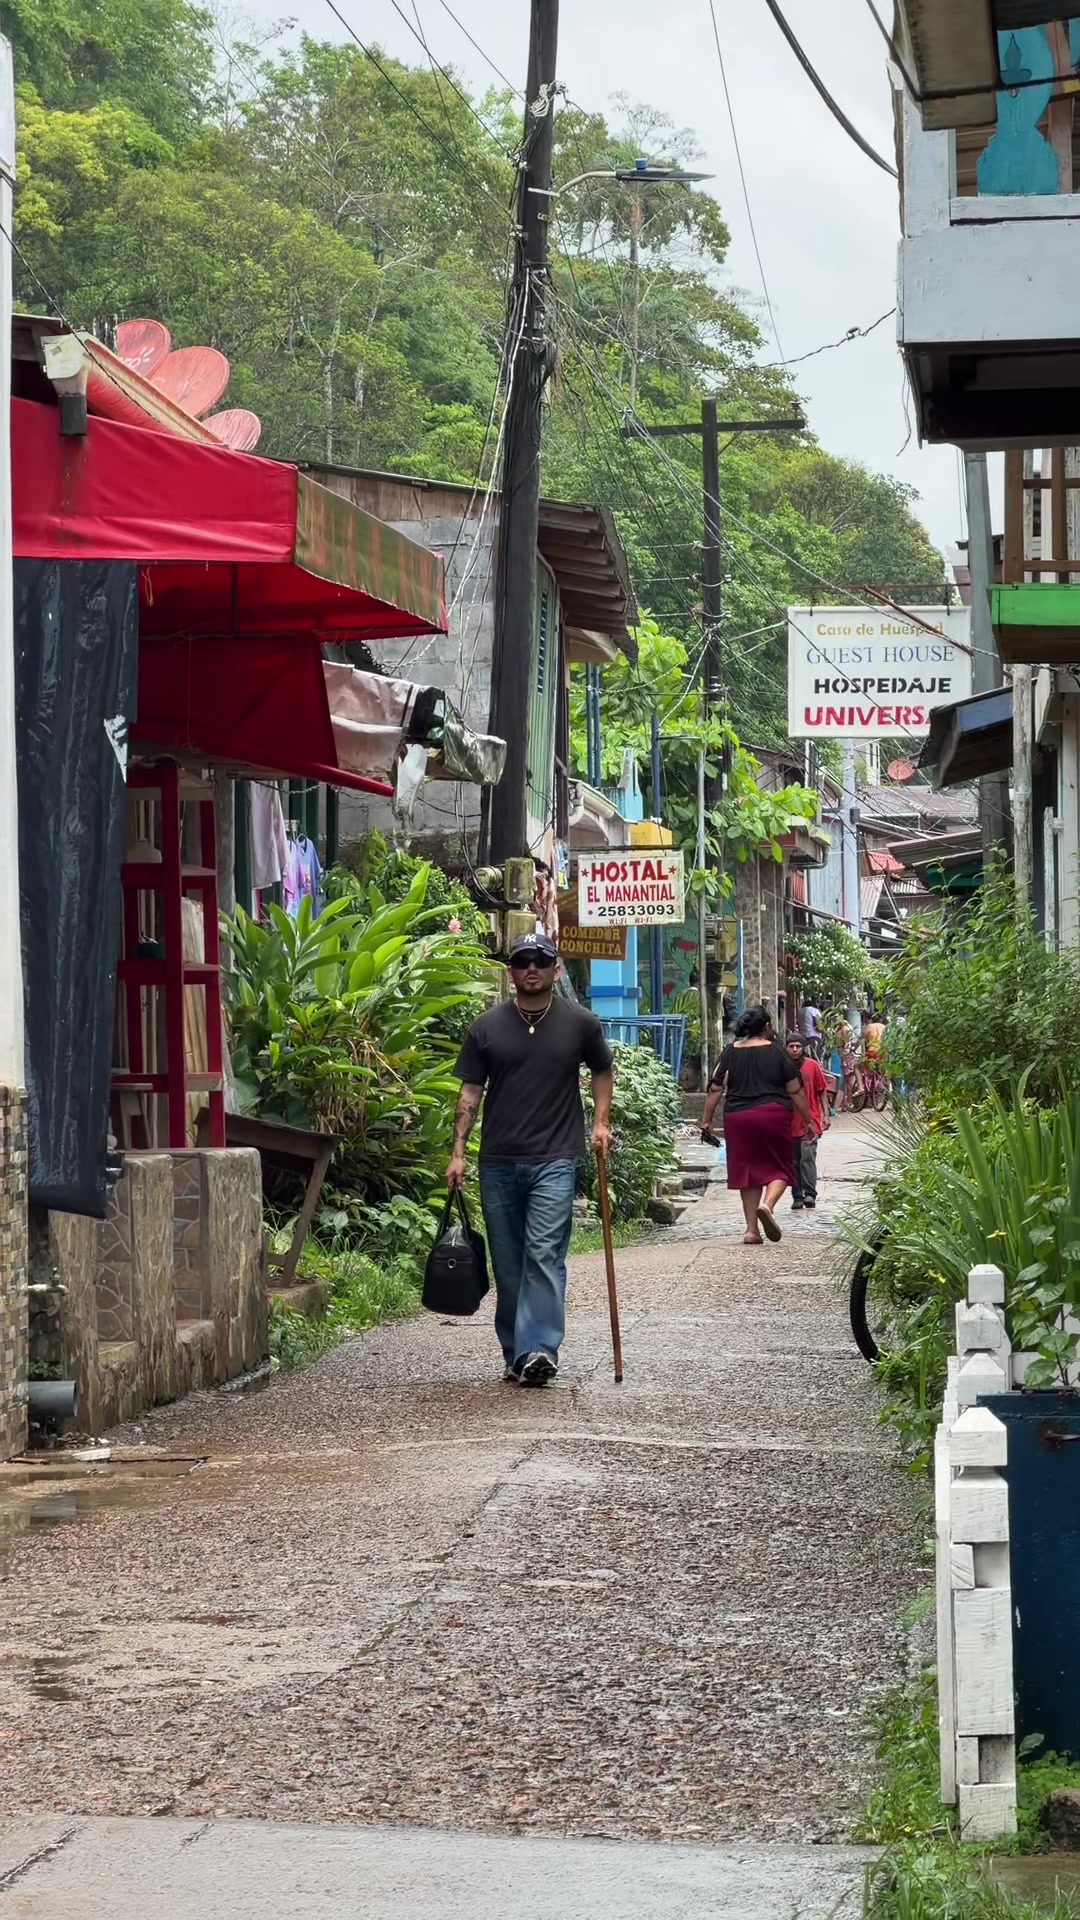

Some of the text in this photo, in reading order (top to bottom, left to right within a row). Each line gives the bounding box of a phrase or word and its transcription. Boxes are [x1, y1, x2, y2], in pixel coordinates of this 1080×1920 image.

[816, 622, 943, 637] Casa de Huespd
[806, 645, 955, 664] GUEST HOUSE
[814, 677, 952, 694] HOSPEDAJE
[591, 860, 668, 882] HOSTAL
[587, 883, 675, 902] EL MANANTIAL
[598, 904, 675, 916] 25833093
[562, 925, 621, 940] COMEDOR
[560, 940, 622, 955] CONCHITA
